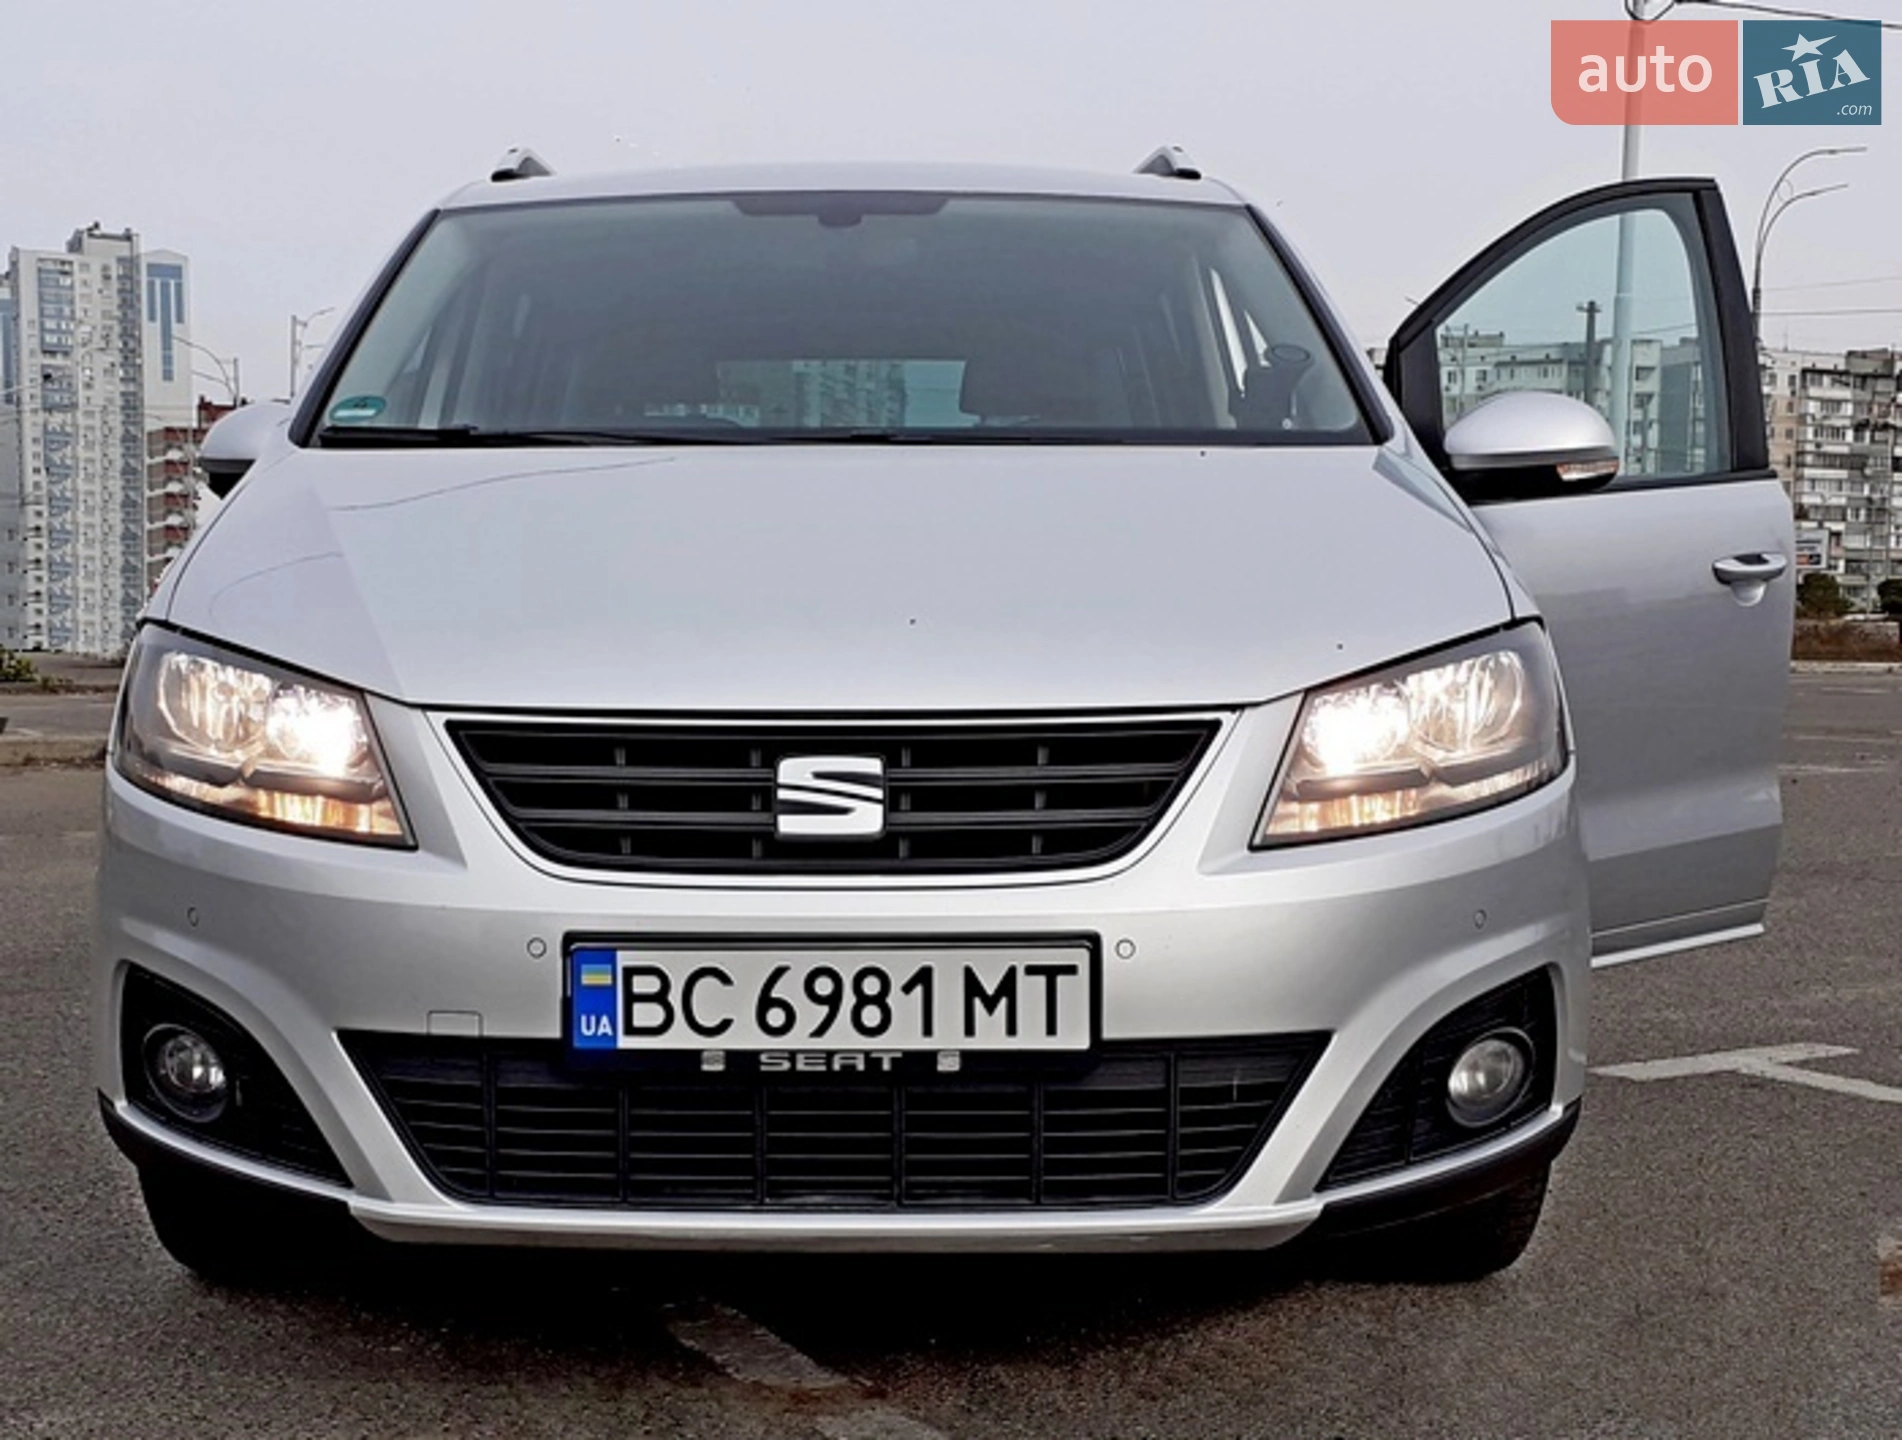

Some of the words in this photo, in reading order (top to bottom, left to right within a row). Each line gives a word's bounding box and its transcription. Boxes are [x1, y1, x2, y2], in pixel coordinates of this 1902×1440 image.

[622, 965, 735, 1038] BC
[755, 965, 934, 1038] 6981
[963, 964, 1079, 1038] MT
[580, 1015, 613, 1037] UA
[759, 1052, 903, 1072] SEAT
